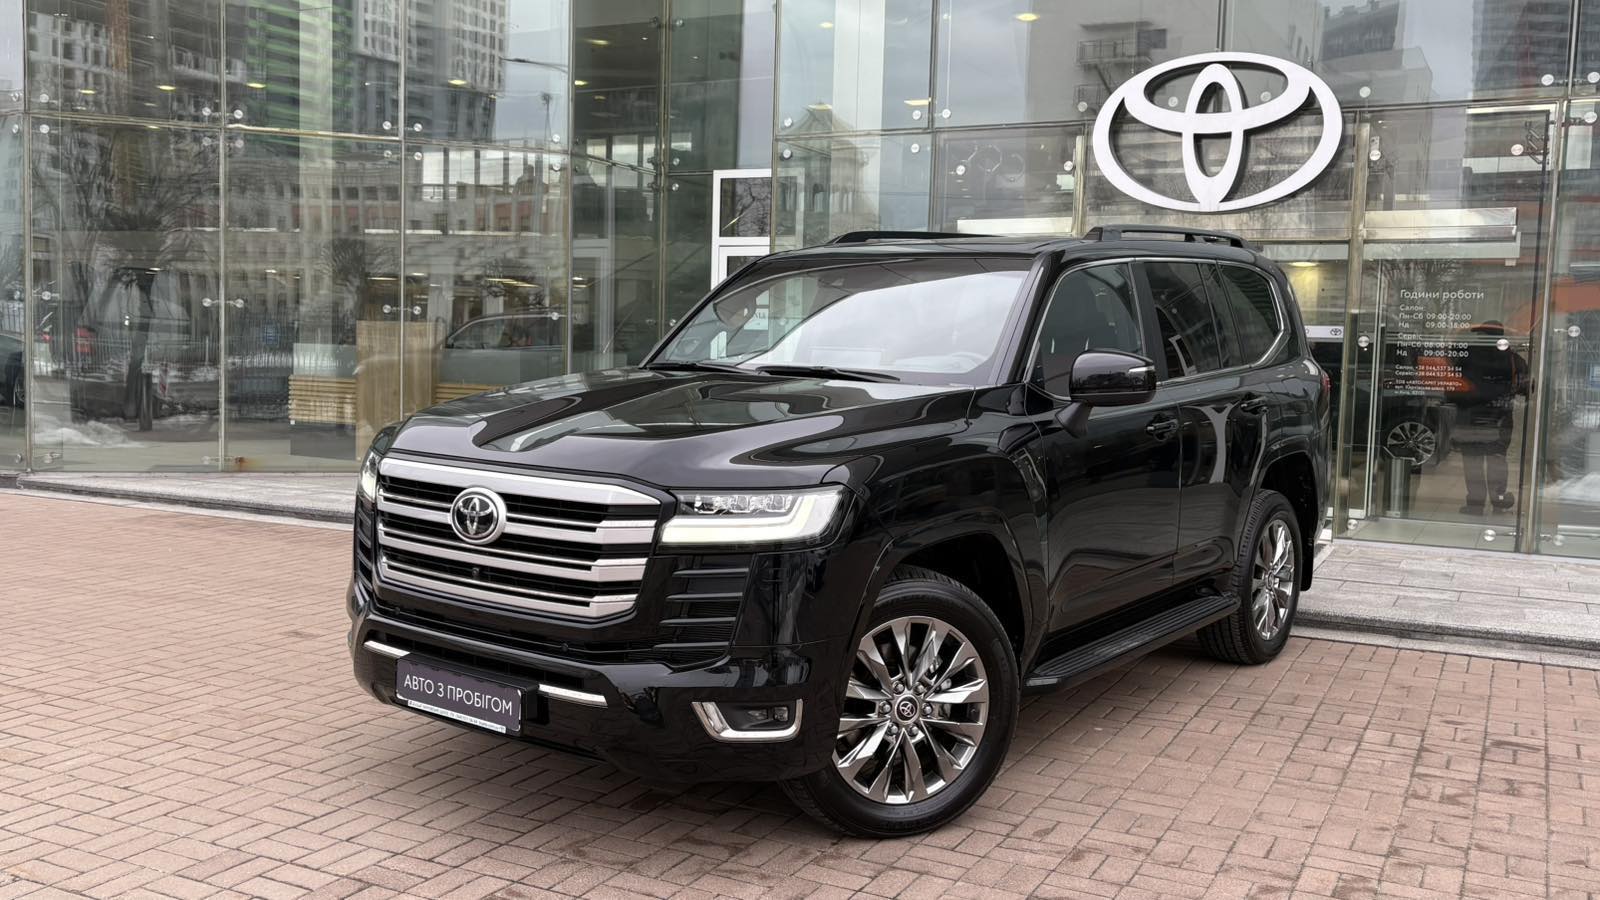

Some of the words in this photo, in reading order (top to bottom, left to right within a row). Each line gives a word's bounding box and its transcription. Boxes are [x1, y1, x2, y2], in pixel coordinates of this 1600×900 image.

[1400, 289, 1440, 299] Години
[1442, 289, 1485, 302] роботи
[1399, 312, 1423, 320] Пн-Сб
[1398, 321, 1410, 329] Нд
[1396, 349, 1408, 357] Нд
[404, 674, 435, 694] АВТО
[447, 685, 513, 716] ПРОБІГОМ
